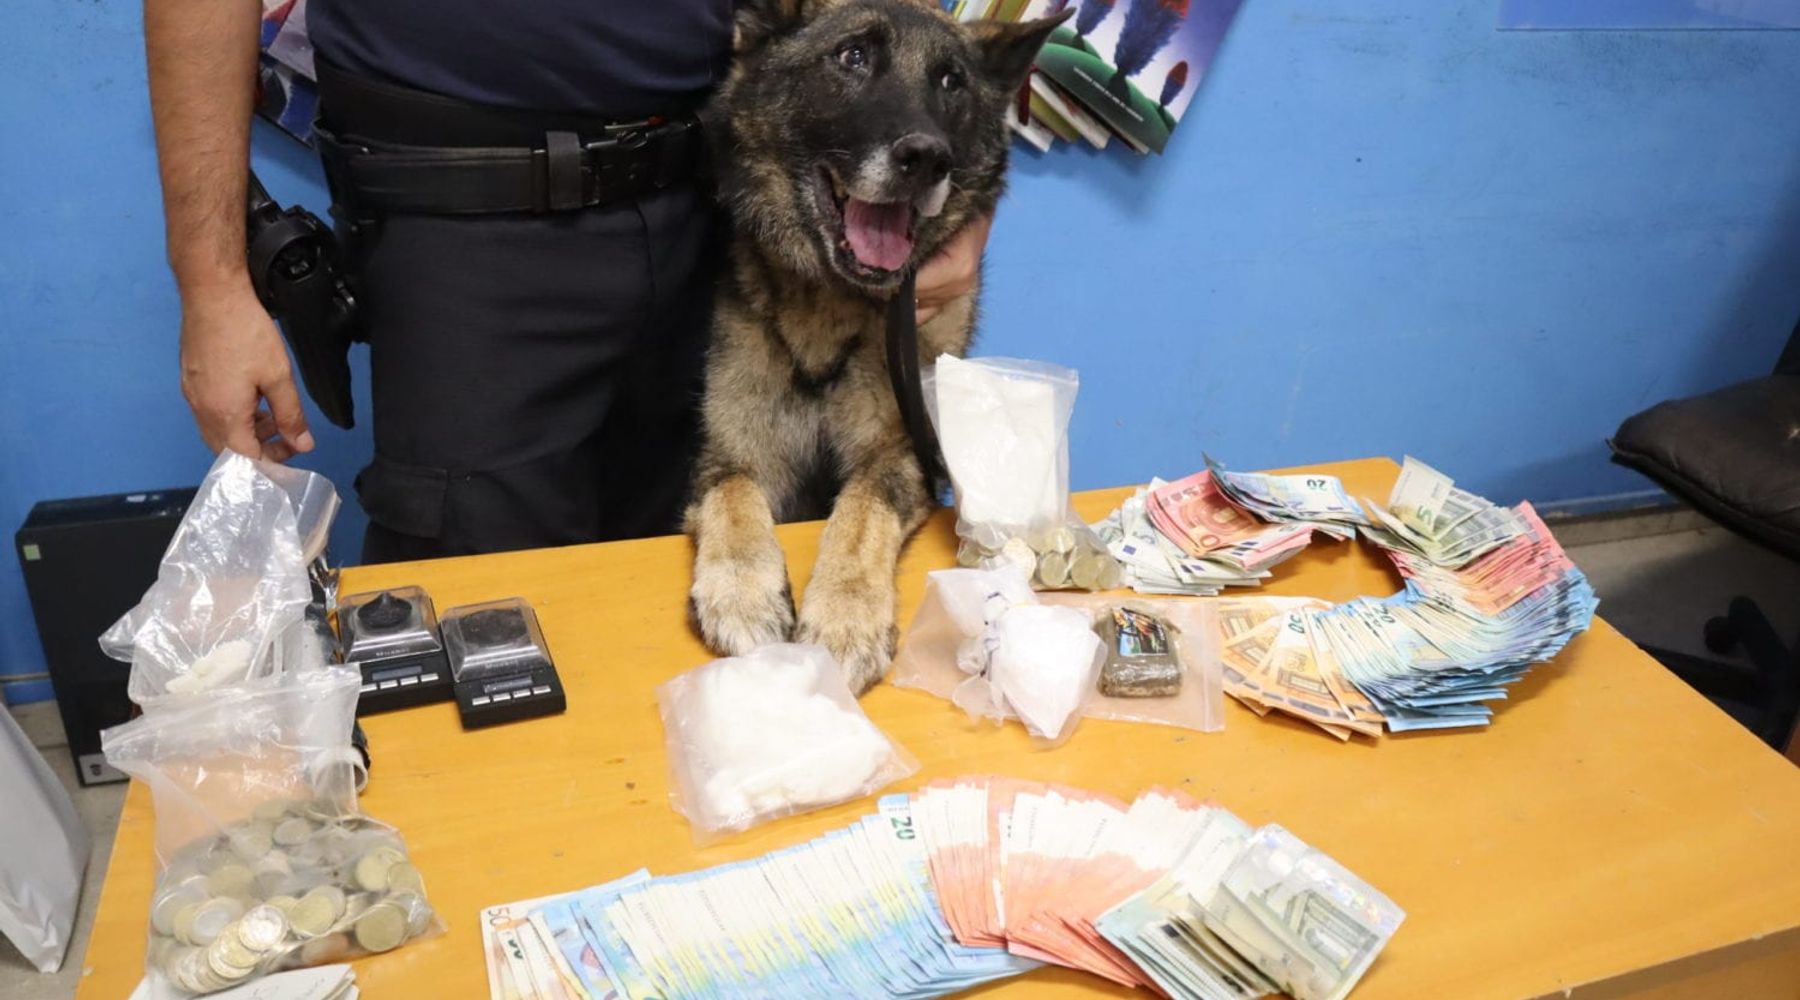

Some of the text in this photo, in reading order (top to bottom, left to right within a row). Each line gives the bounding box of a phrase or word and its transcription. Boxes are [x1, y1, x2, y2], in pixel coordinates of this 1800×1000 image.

[1415, 505, 1432, 526] 5
[1287, 614, 1305, 634] 50
[890, 816, 916, 841] 20
